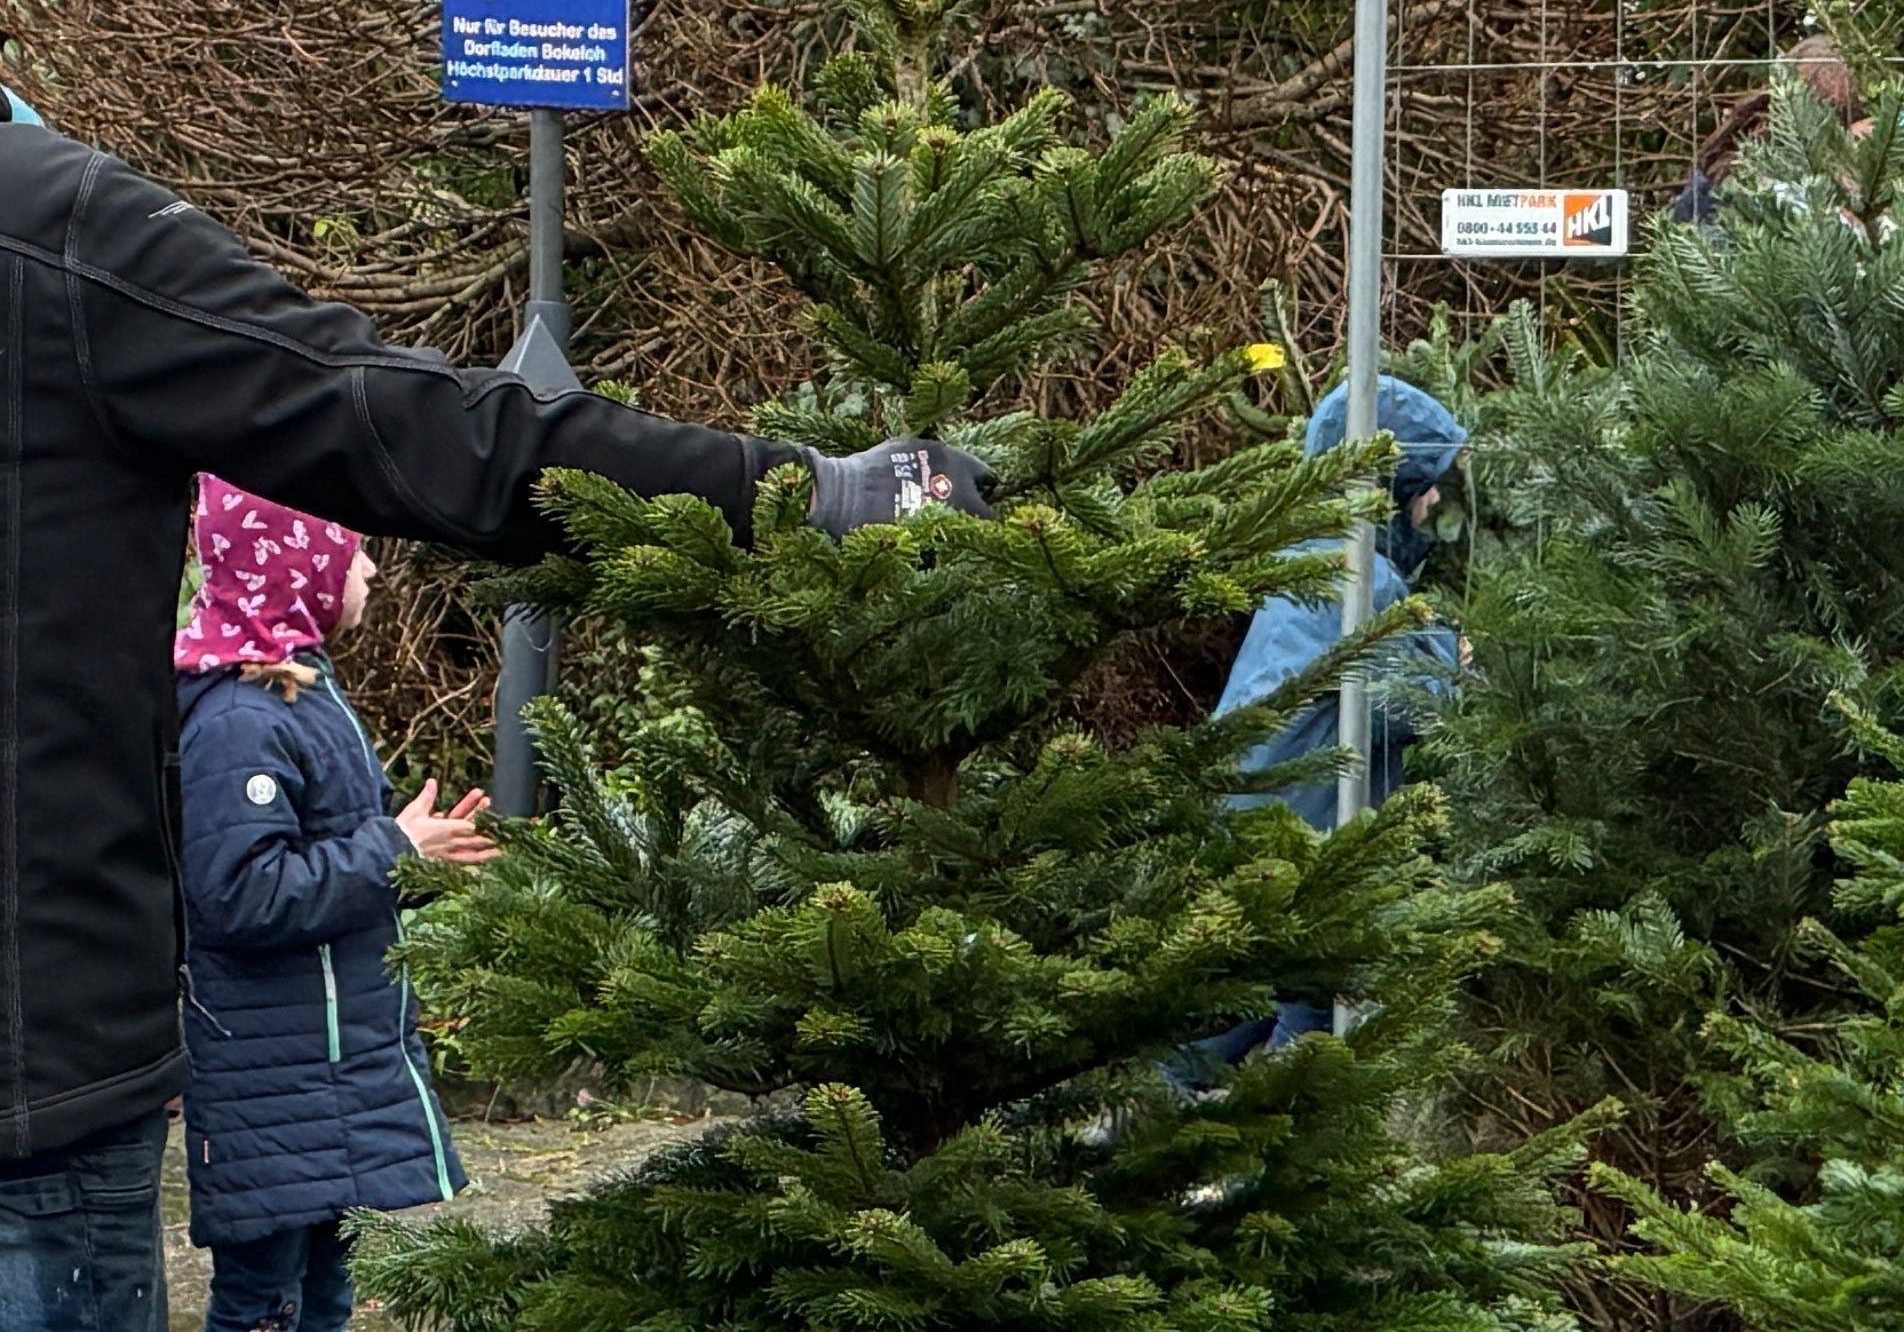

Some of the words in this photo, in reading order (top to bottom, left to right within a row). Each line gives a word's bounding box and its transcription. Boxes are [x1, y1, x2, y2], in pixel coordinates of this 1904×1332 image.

[453, 16, 481, 34] Nur
[484, 17, 506, 35] für
[509, 19, 585, 38] Besucher
[464, 39, 538, 58] Dorfladen
[447, 60, 580, 82] Höchstparkdauer
[583, 66, 592, 83] 1
[1457, 194, 1483, 207] HKL
[1486, 194, 1557, 208] MIETPARK
[1567, 195, 1611, 239] HKL
[1457, 222, 1488, 234] 0800
